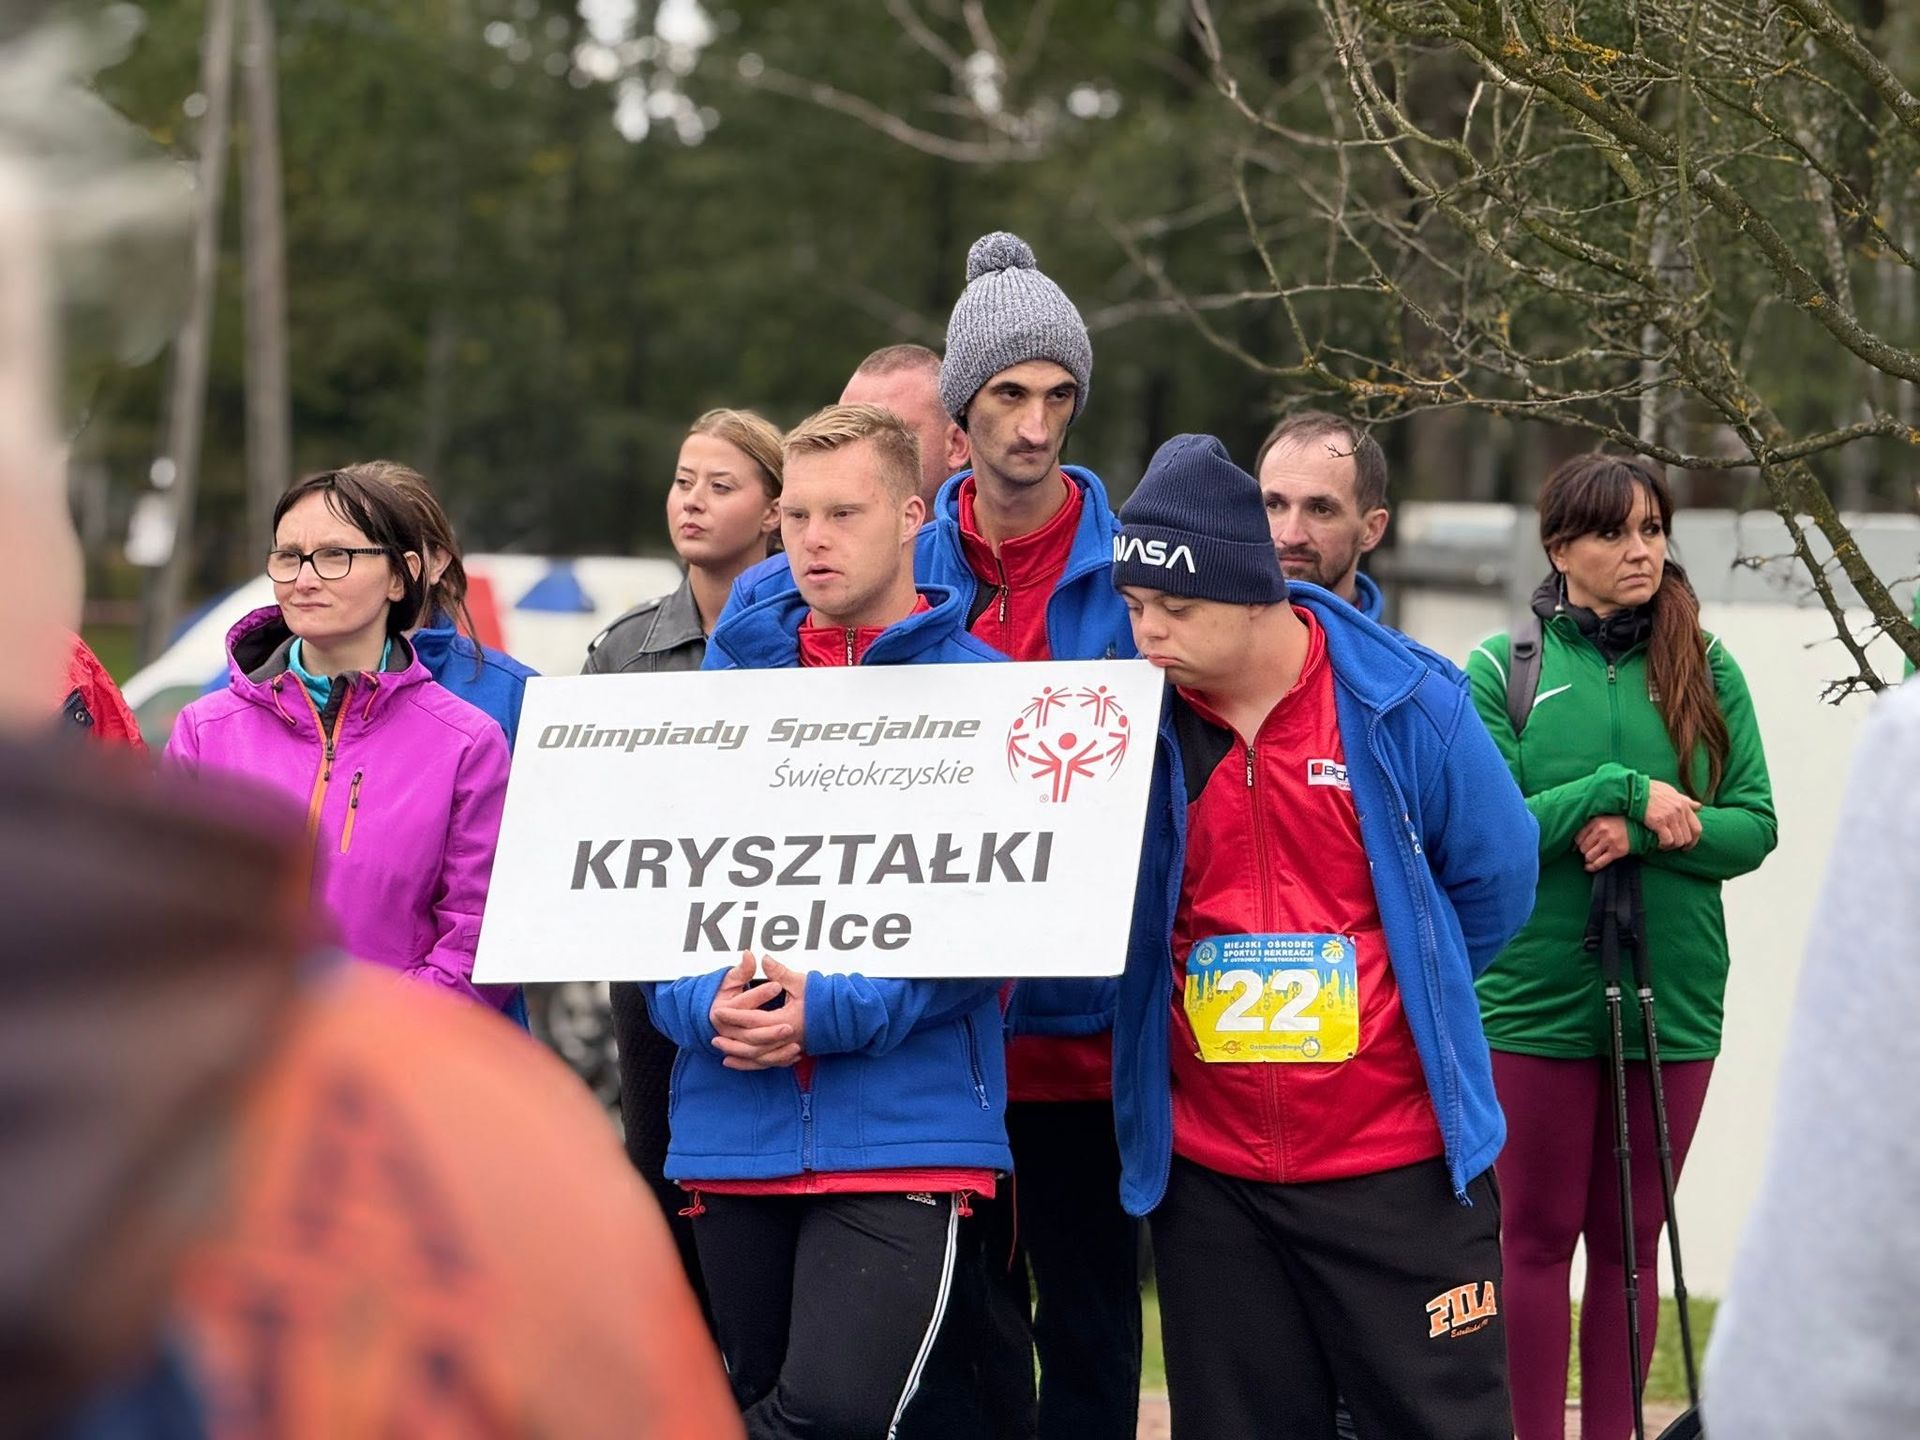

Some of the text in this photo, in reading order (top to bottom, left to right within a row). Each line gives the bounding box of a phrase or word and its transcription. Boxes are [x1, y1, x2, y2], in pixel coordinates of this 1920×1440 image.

[1113, 535, 1196, 574] NASA
[537, 715, 981, 753] Olimpiady Specjalne
[768, 757, 974, 792] Świętokrzyskie
[569, 831, 1055, 890] KRYSZTAŁKI
[682, 900, 912, 953] Kielce
[1223, 940, 1314, 949] MIEJSKI OŚRODEK
[1223, 949, 1257, 957] SPORTU
[1263, 949, 1314, 957] REKREACJI
[1215, 969, 1320, 1032] 22
[1425, 1280, 1497, 1339] FILA
